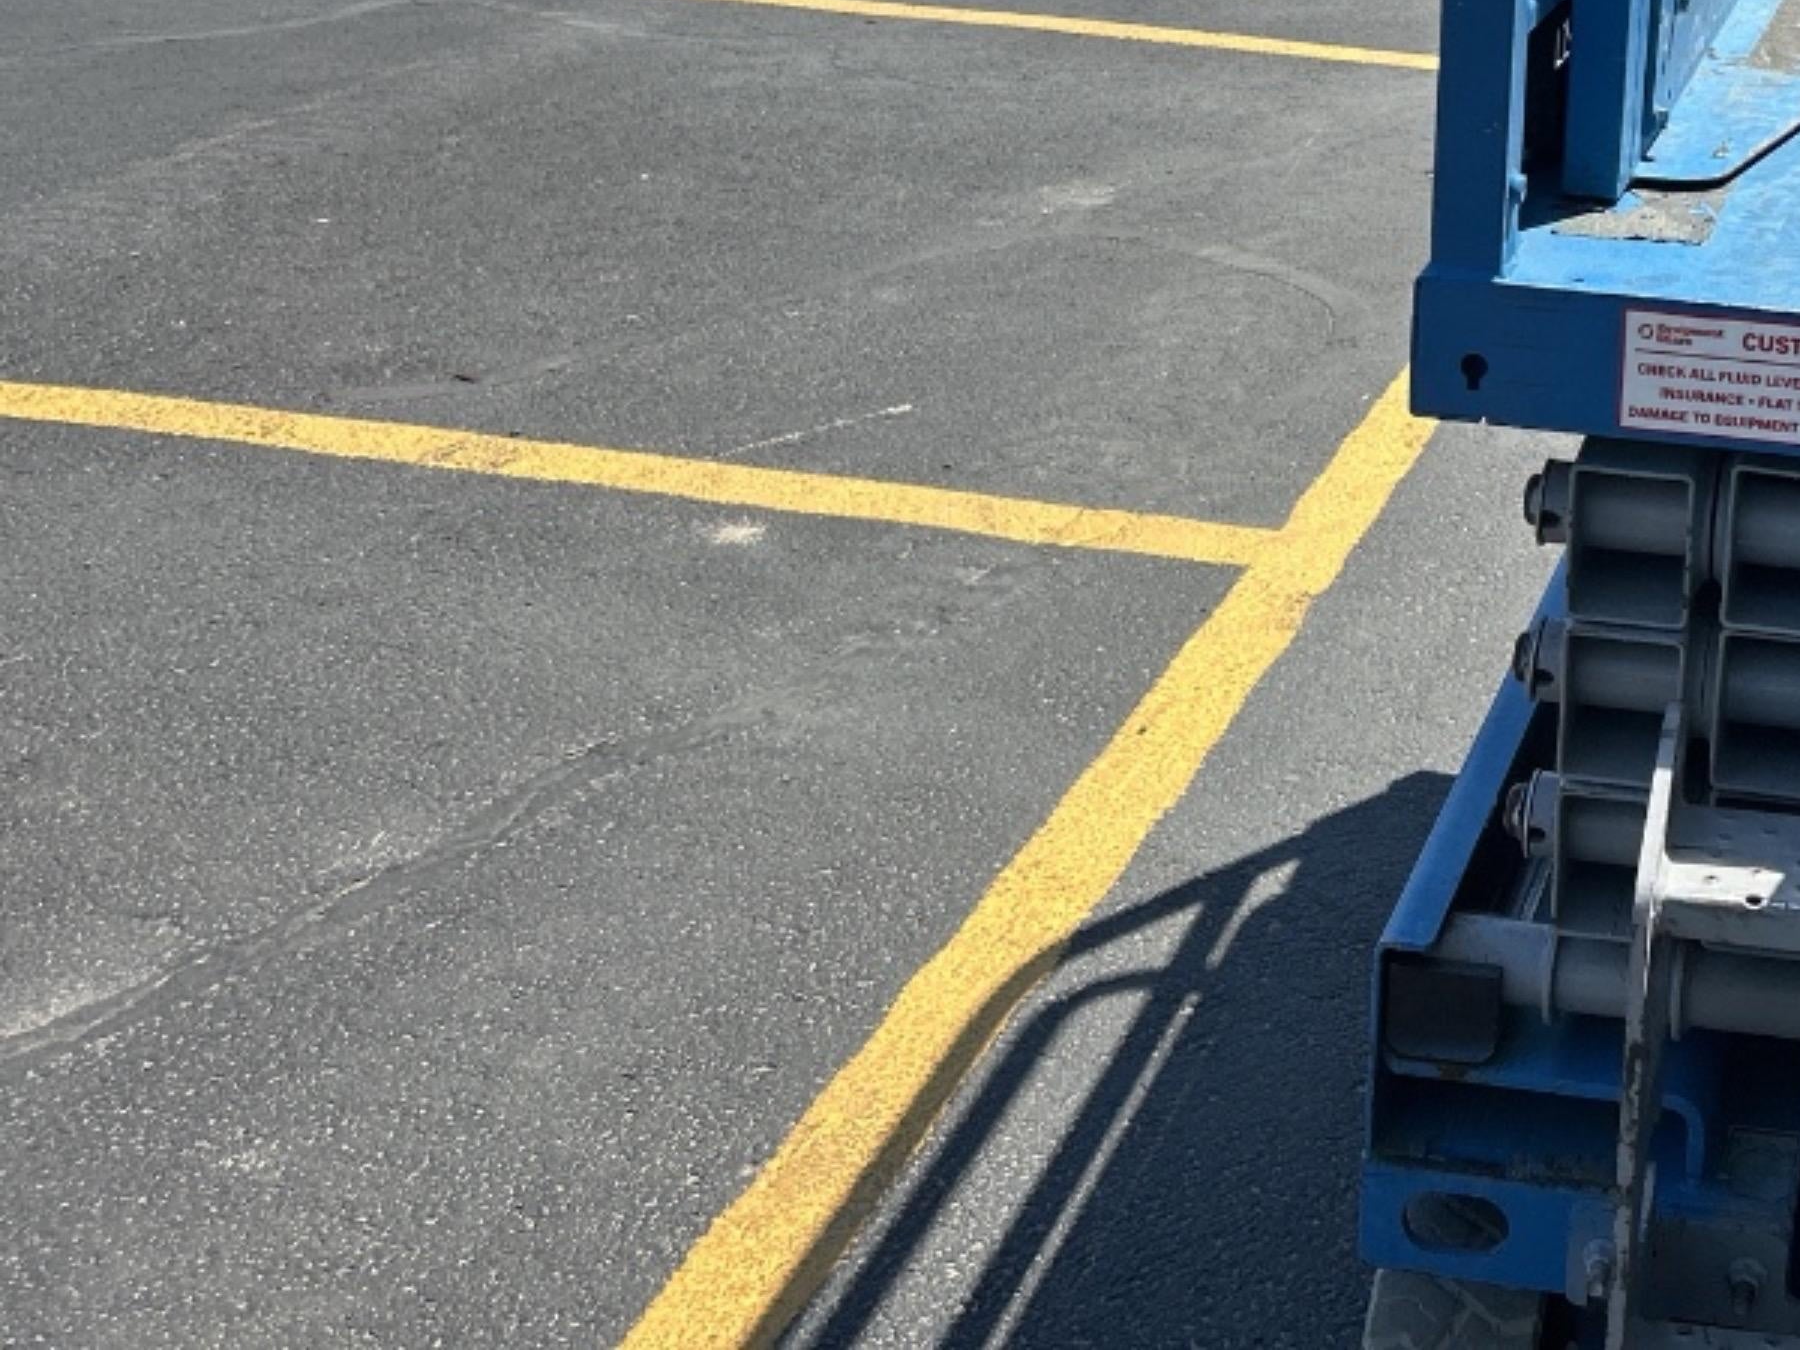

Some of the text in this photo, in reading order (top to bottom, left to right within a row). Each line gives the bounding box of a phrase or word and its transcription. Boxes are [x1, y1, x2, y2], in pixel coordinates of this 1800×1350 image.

[1637, 361, 1686, 380] CHECK
[1689, 366, 1716, 382] ALL
[1719, 370, 1762, 386] FLUID
[1659, 386, 1744, 407] INSURANCE
[1758, 396, 1792, 412] FLAT
[1628, 405, 1688, 422] DAMAGE
[1693, 411, 1711, 424] TO
[1714, 414, 1799, 434] EQUIPMENT
